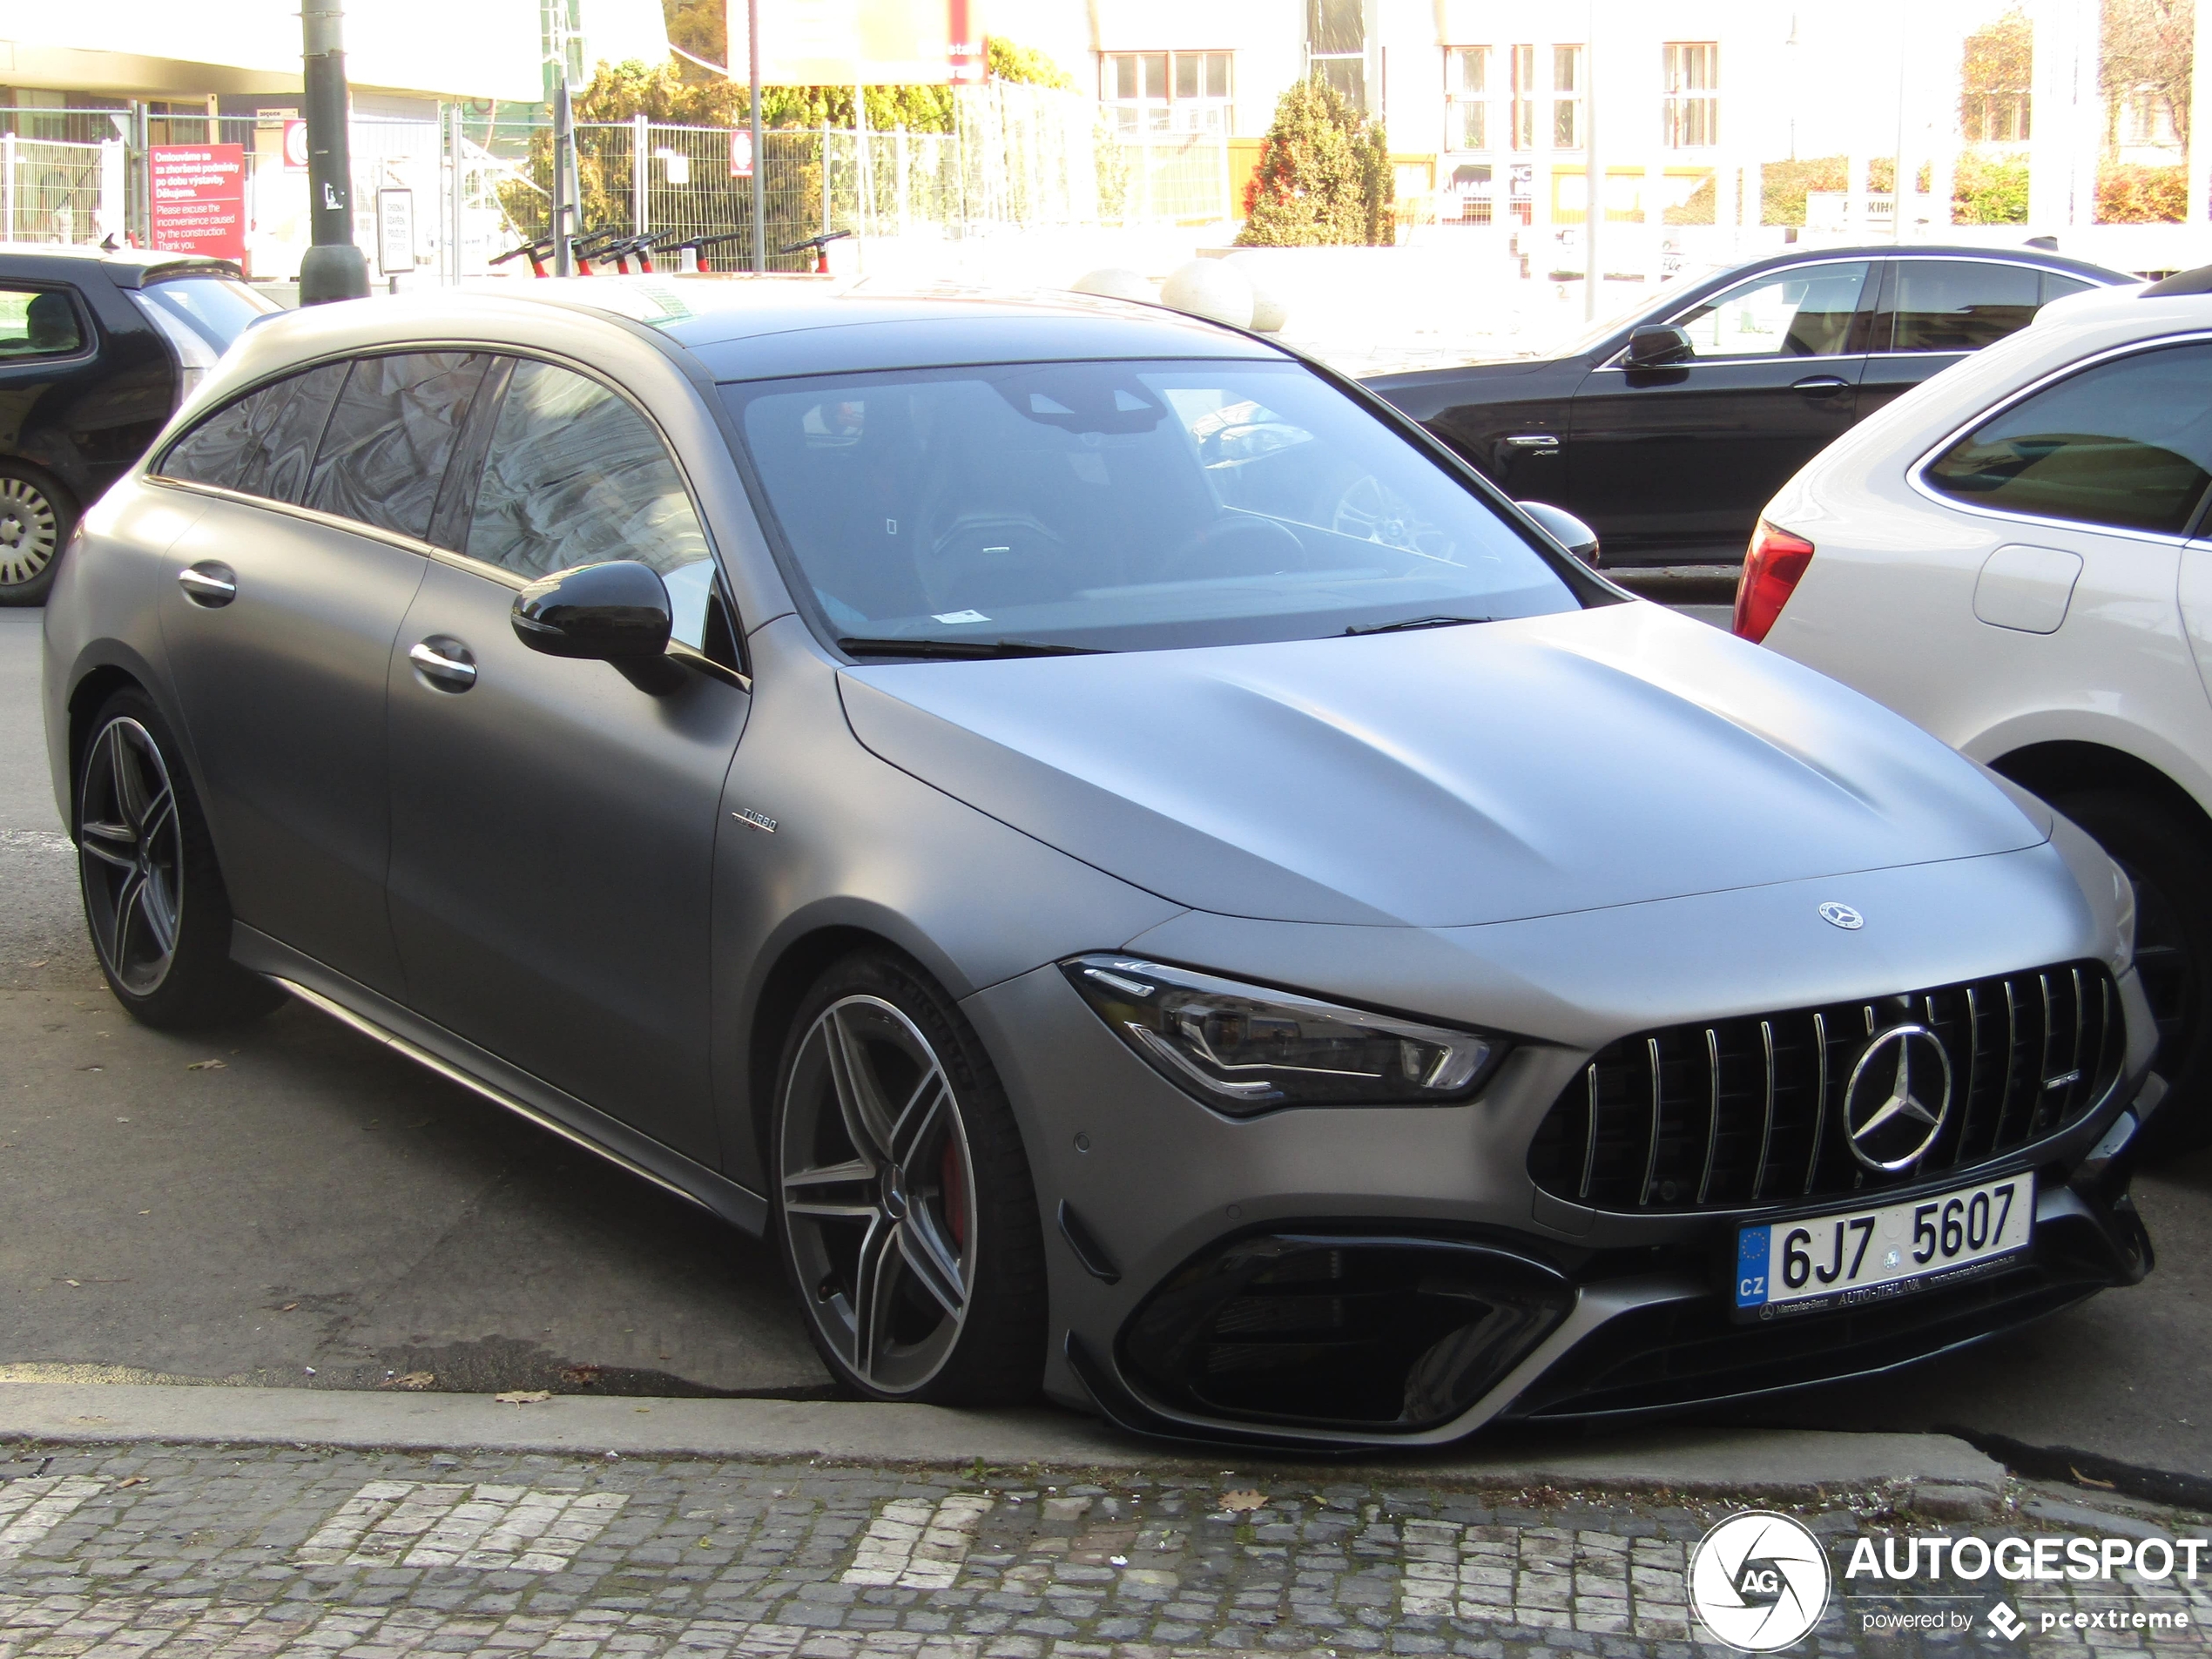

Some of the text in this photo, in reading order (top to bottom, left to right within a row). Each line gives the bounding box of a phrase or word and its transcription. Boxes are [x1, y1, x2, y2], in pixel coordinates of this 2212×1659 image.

[155, 152, 201, 162] Omlouváme
[165, 164, 201, 174] zhoršené
[202, 163, 239, 174] podmínky
[156, 175, 225, 188] po dobu výstavby.
[156, 188, 197, 199] Děkujeme.
[157, 206, 181, 214] Please
[208, 204, 220, 212] the
[1843, 201, 1893, 212] PKIN
[157, 214, 235, 226] inconvenience caused
[157, 226, 227, 240] by the construction.
[158, 241, 196, 252] Thank you.
[744, 807, 778, 829] TURBO
[1782, 1182, 2015, 1289] 6J7 5607
[1740, 1277, 1764, 1297] CZ
[1777, 1298, 1829, 1314] Mercedes-Benz
[1838, 1278, 1921, 1305] AUTO-JIHLAVA
